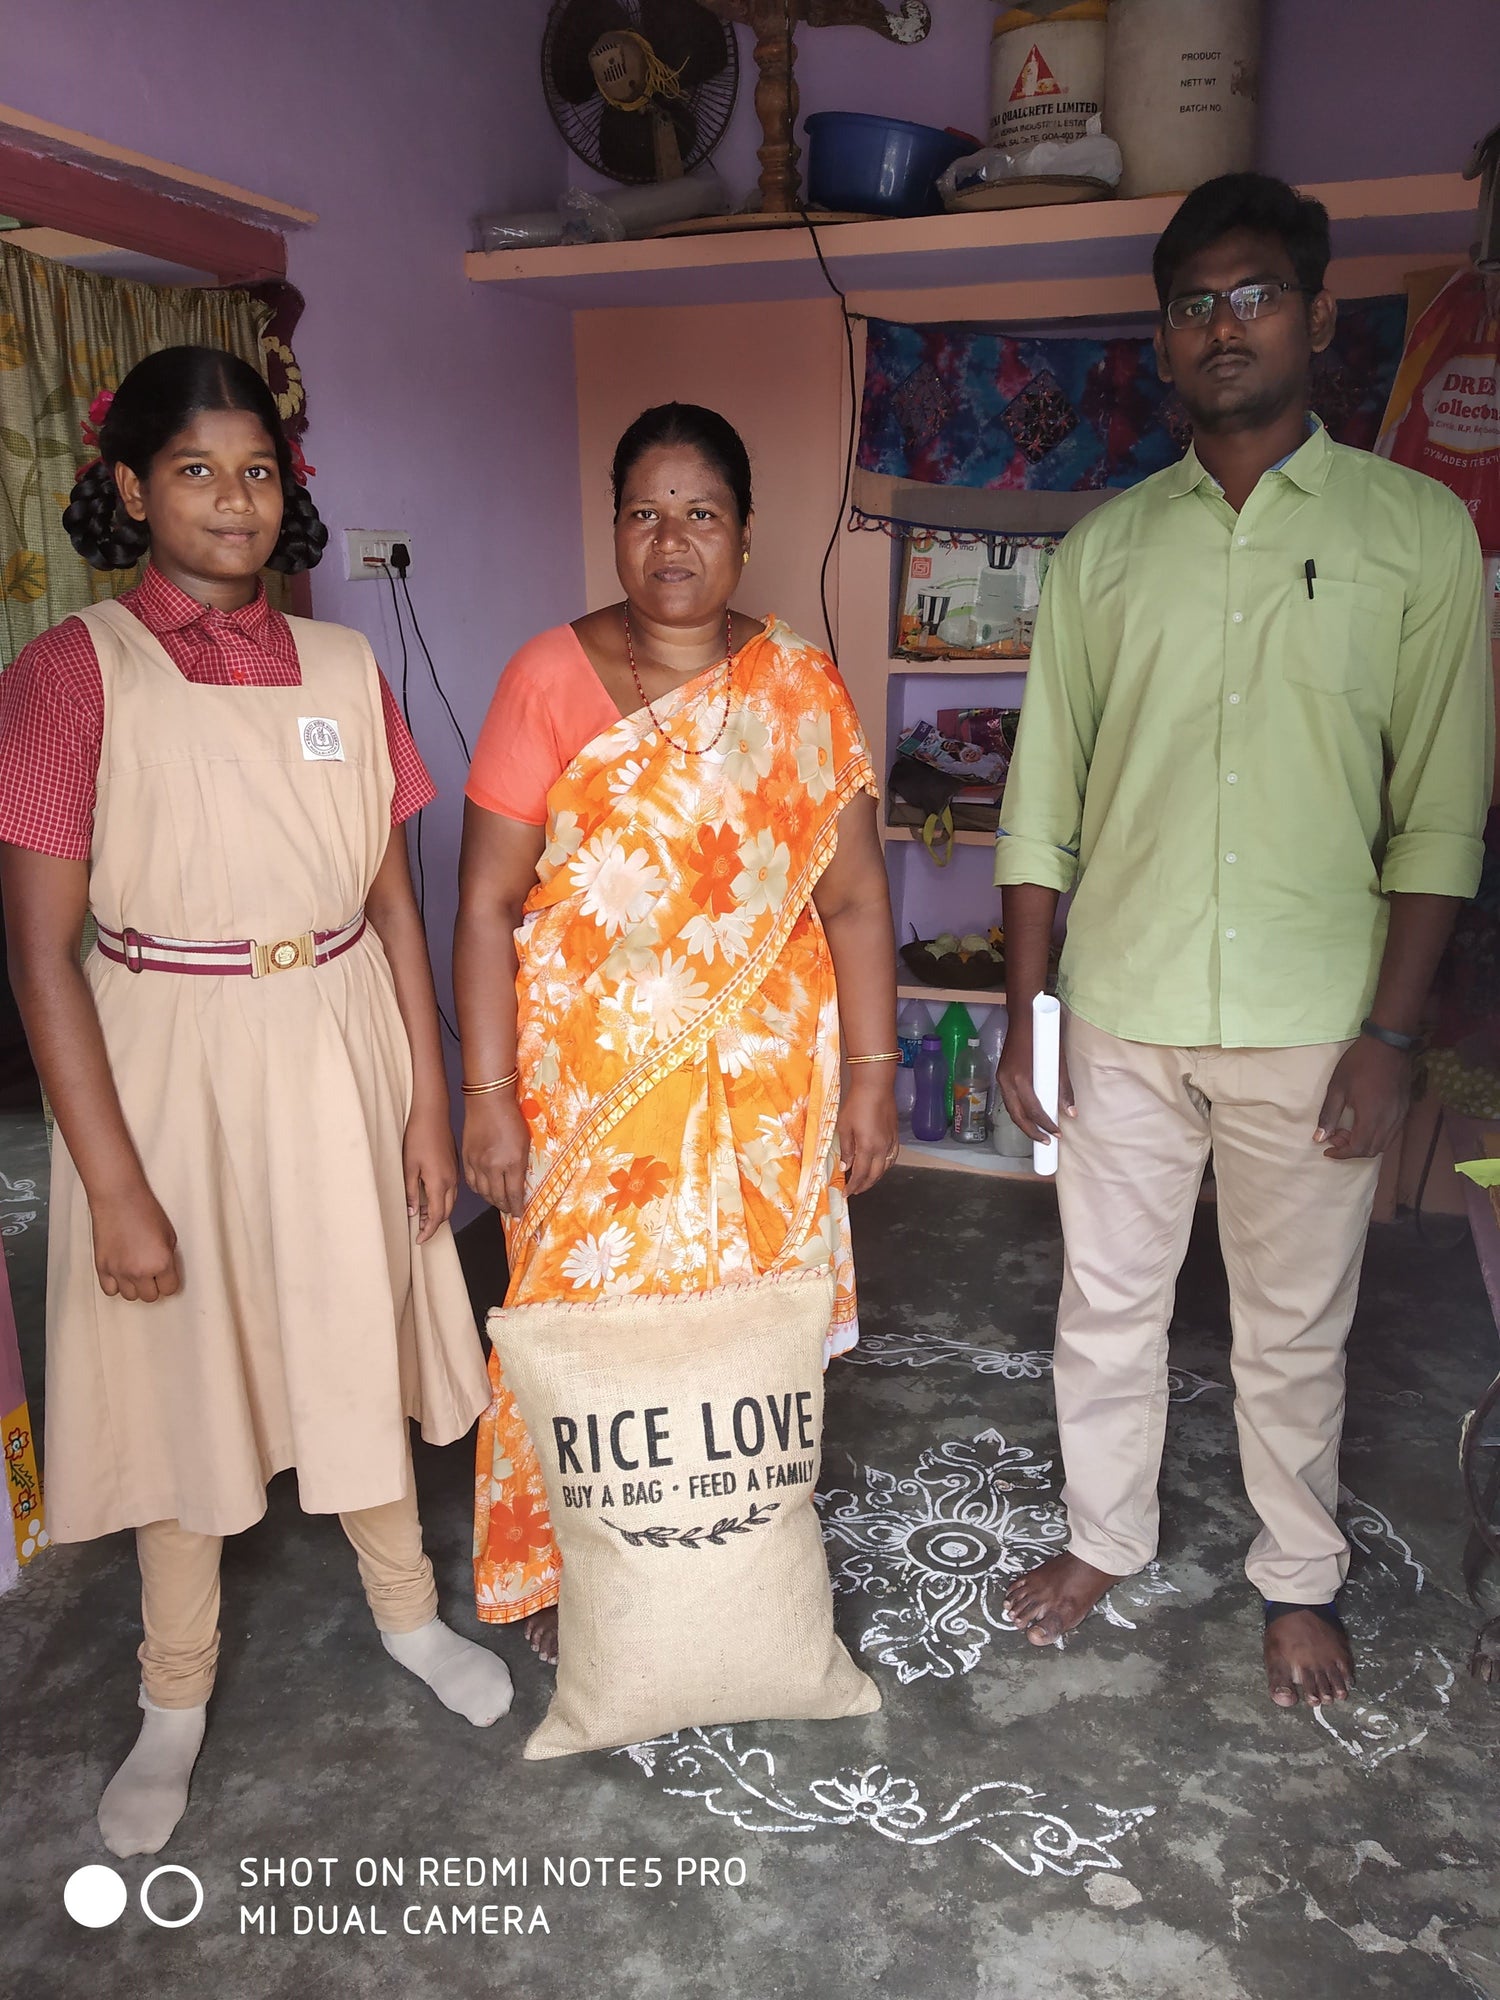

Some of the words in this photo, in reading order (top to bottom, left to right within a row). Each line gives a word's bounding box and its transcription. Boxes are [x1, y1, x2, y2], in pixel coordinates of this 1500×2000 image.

[1181, 52, 1222, 61] PRODUCT
[1180, 78, 1201, 87] NETT
[1204, 77, 1217, 86] WT
[1002, 103, 1054, 125] QUALCRETE
[1056, 101, 1098, 114] LIMITED
[1179, 104, 1207, 113] BATCH
[1064, 119, 1087, 128] ESTAT
[552, 1407, 673, 1474] RICE
[701, 1391, 814, 1461] LOVE
[562, 1485, 593, 1509] BUY
[601, 1485, 615, 1508] A
[622, 1480, 663, 1506] BAG
[689, 1472, 737, 1499] FEED
[747, 1468, 760, 1492] A
[766, 1459, 814, 1489] FAMILY
